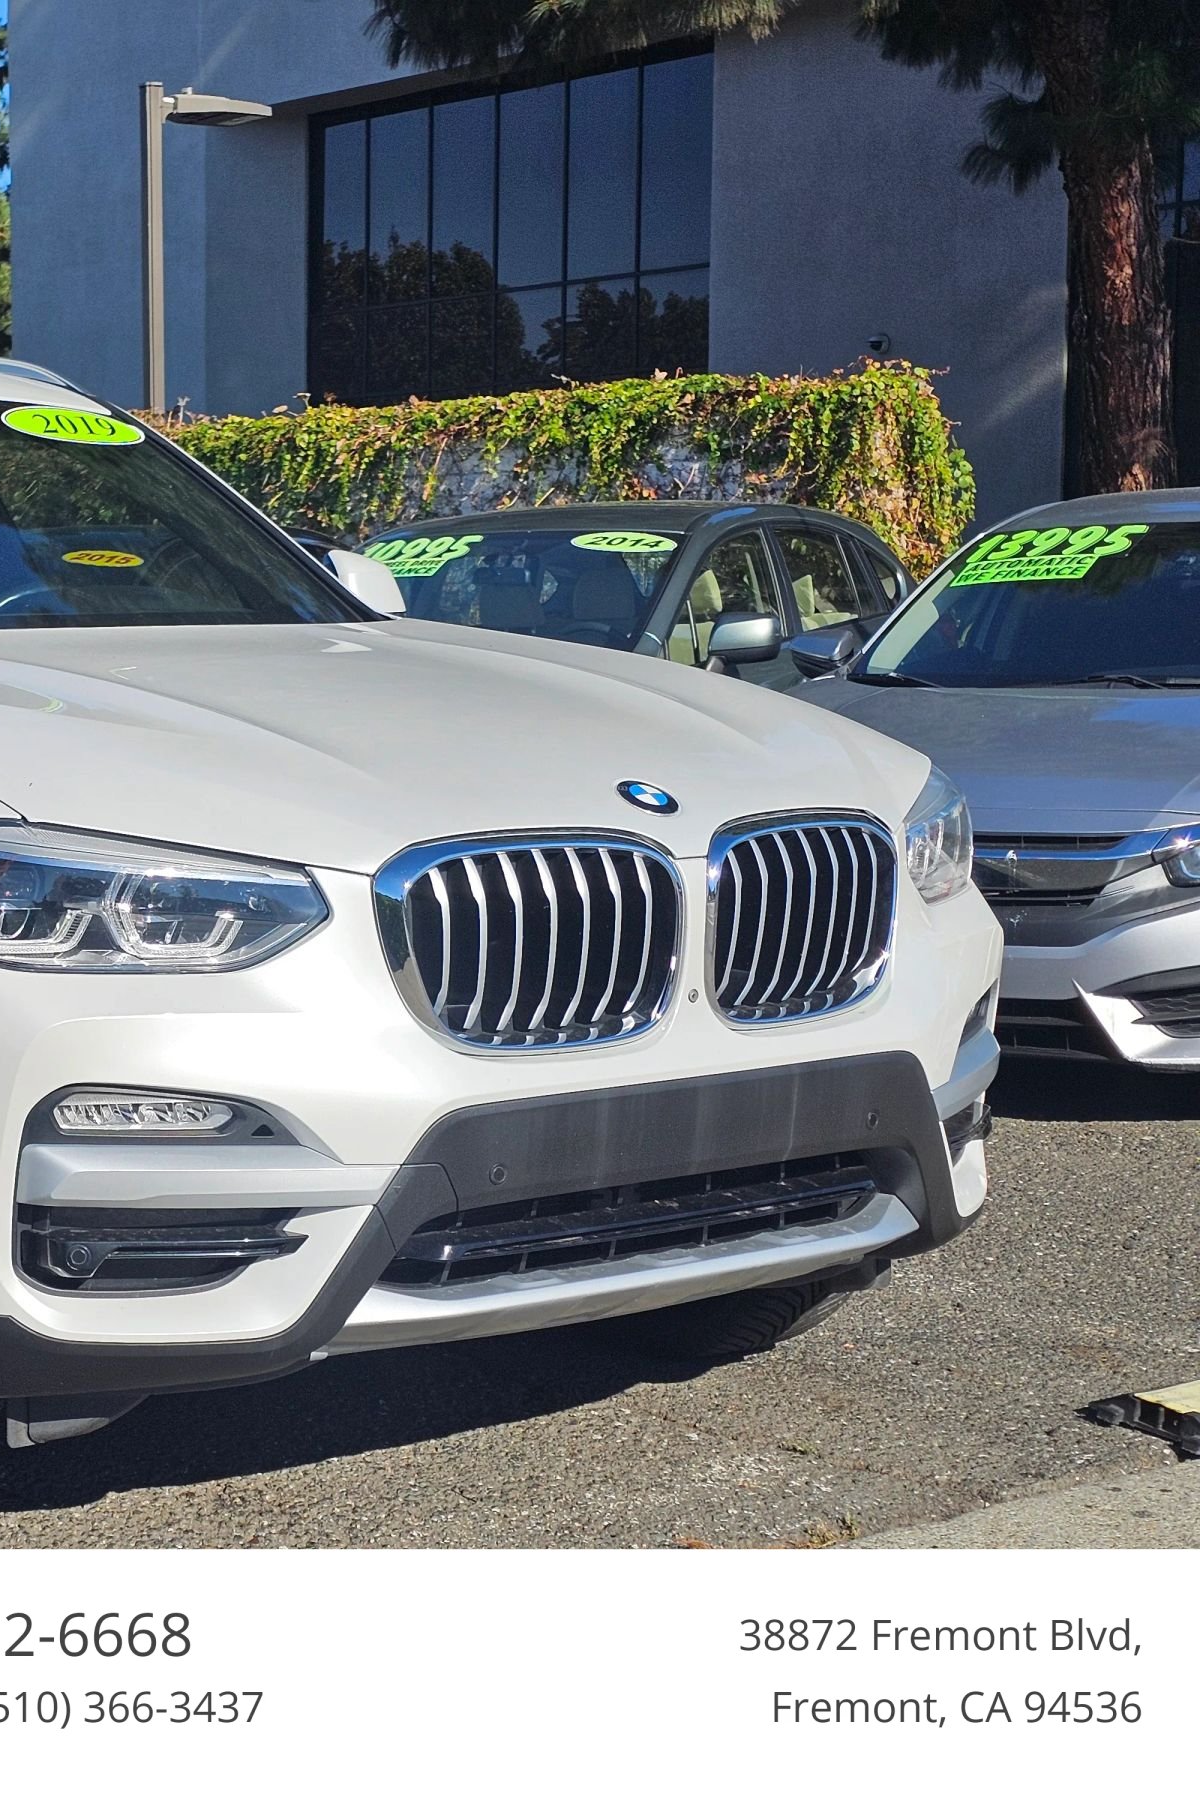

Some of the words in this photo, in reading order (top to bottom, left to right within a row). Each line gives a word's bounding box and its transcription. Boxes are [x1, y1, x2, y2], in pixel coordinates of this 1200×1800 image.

[33, 413, 117, 437] 2019
[363, 535, 484, 560] 10995
[591, 536, 664, 548] 2014
[966, 524, 1149, 564] 13995
[69, 553, 136, 564] 2015
[964, 555, 1095, 574] AUTOMATIC
[956, 571, 988, 584] WE
[990, 565, 1088, 580] FINANCE
